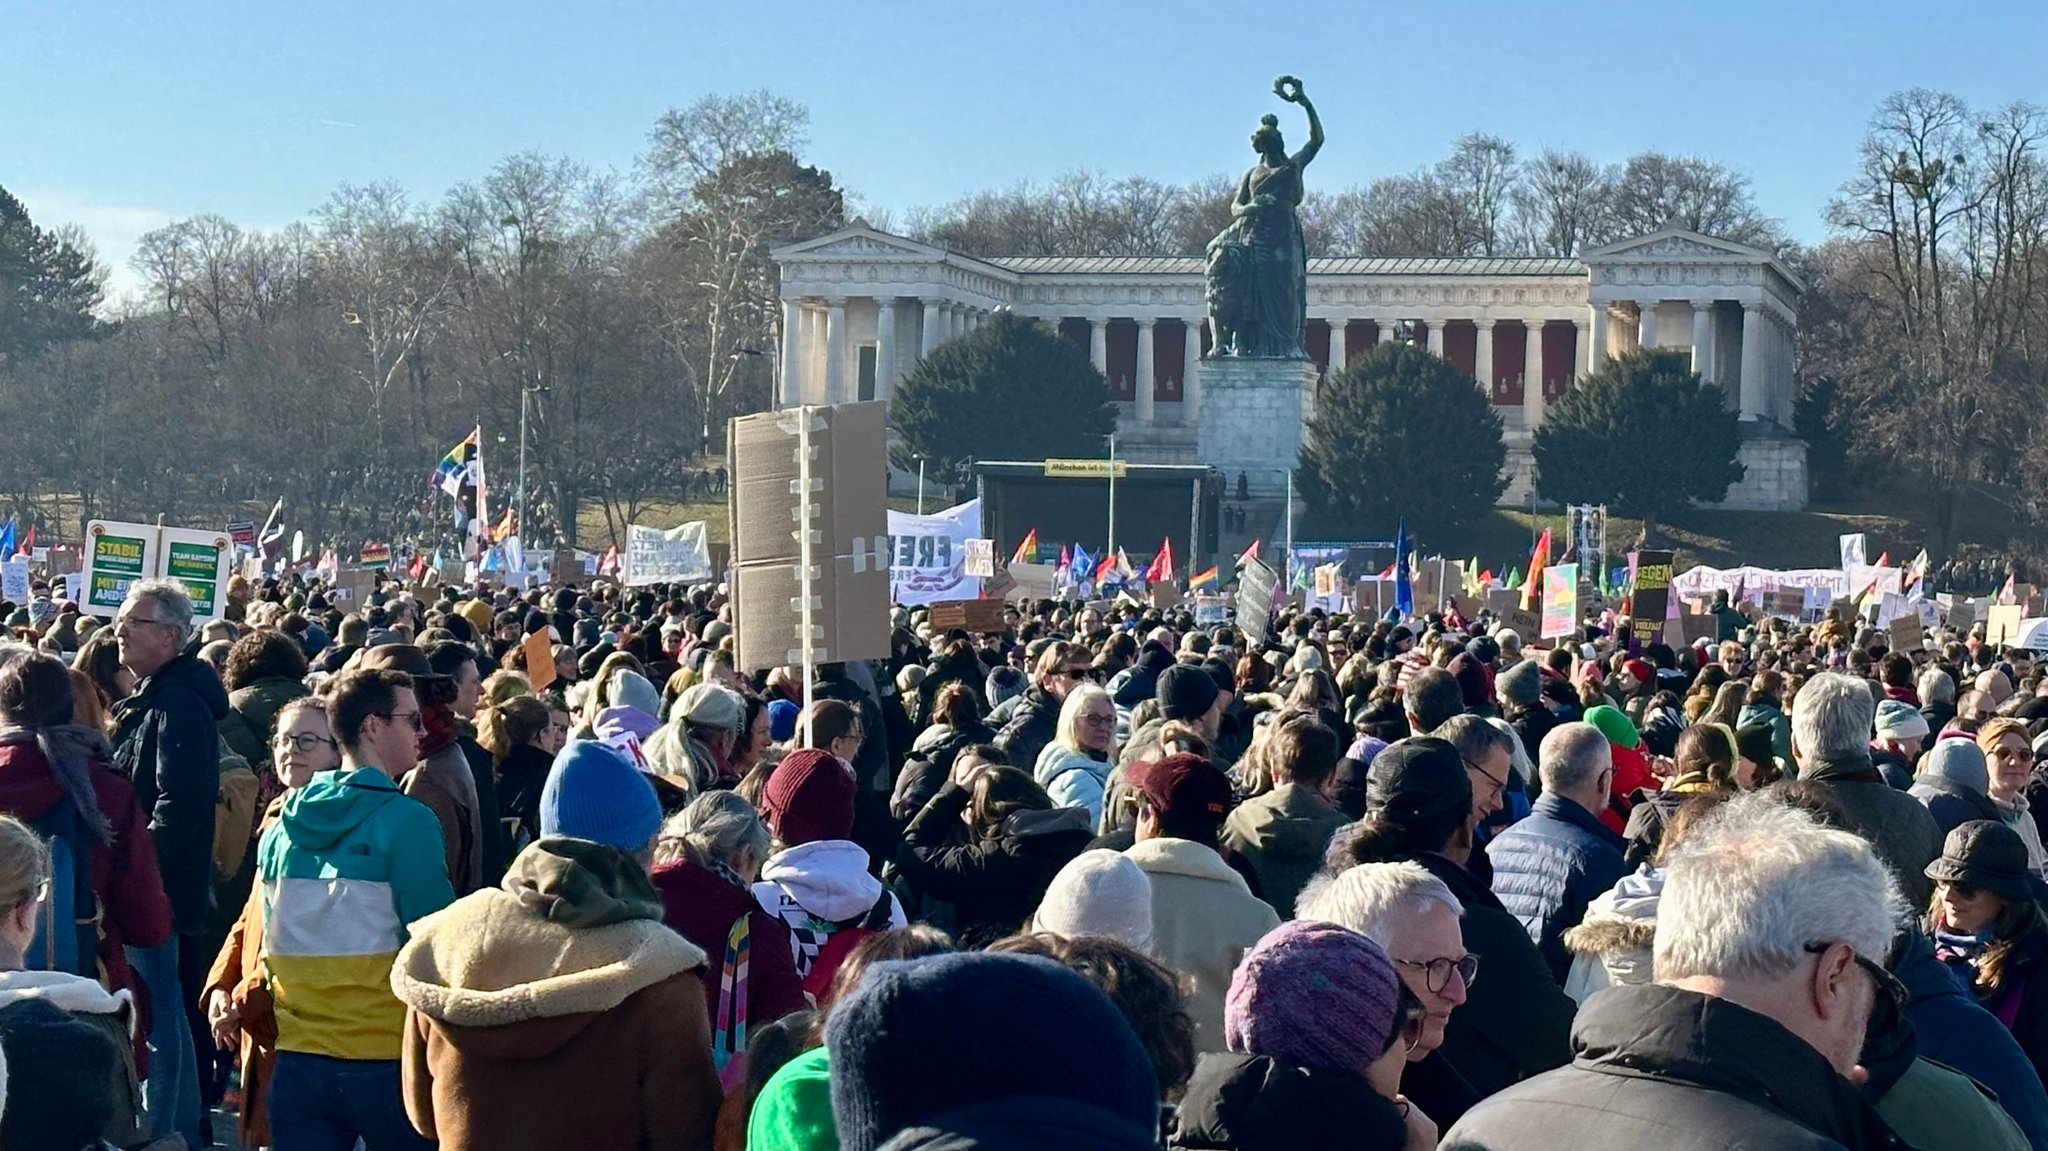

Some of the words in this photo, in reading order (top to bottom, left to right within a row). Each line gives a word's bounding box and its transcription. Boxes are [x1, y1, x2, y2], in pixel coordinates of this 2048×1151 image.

[1052, 462, 1086, 472] München
[97, 542, 141, 557] STABIL
[1637, 564, 1673, 582] GEGEN
